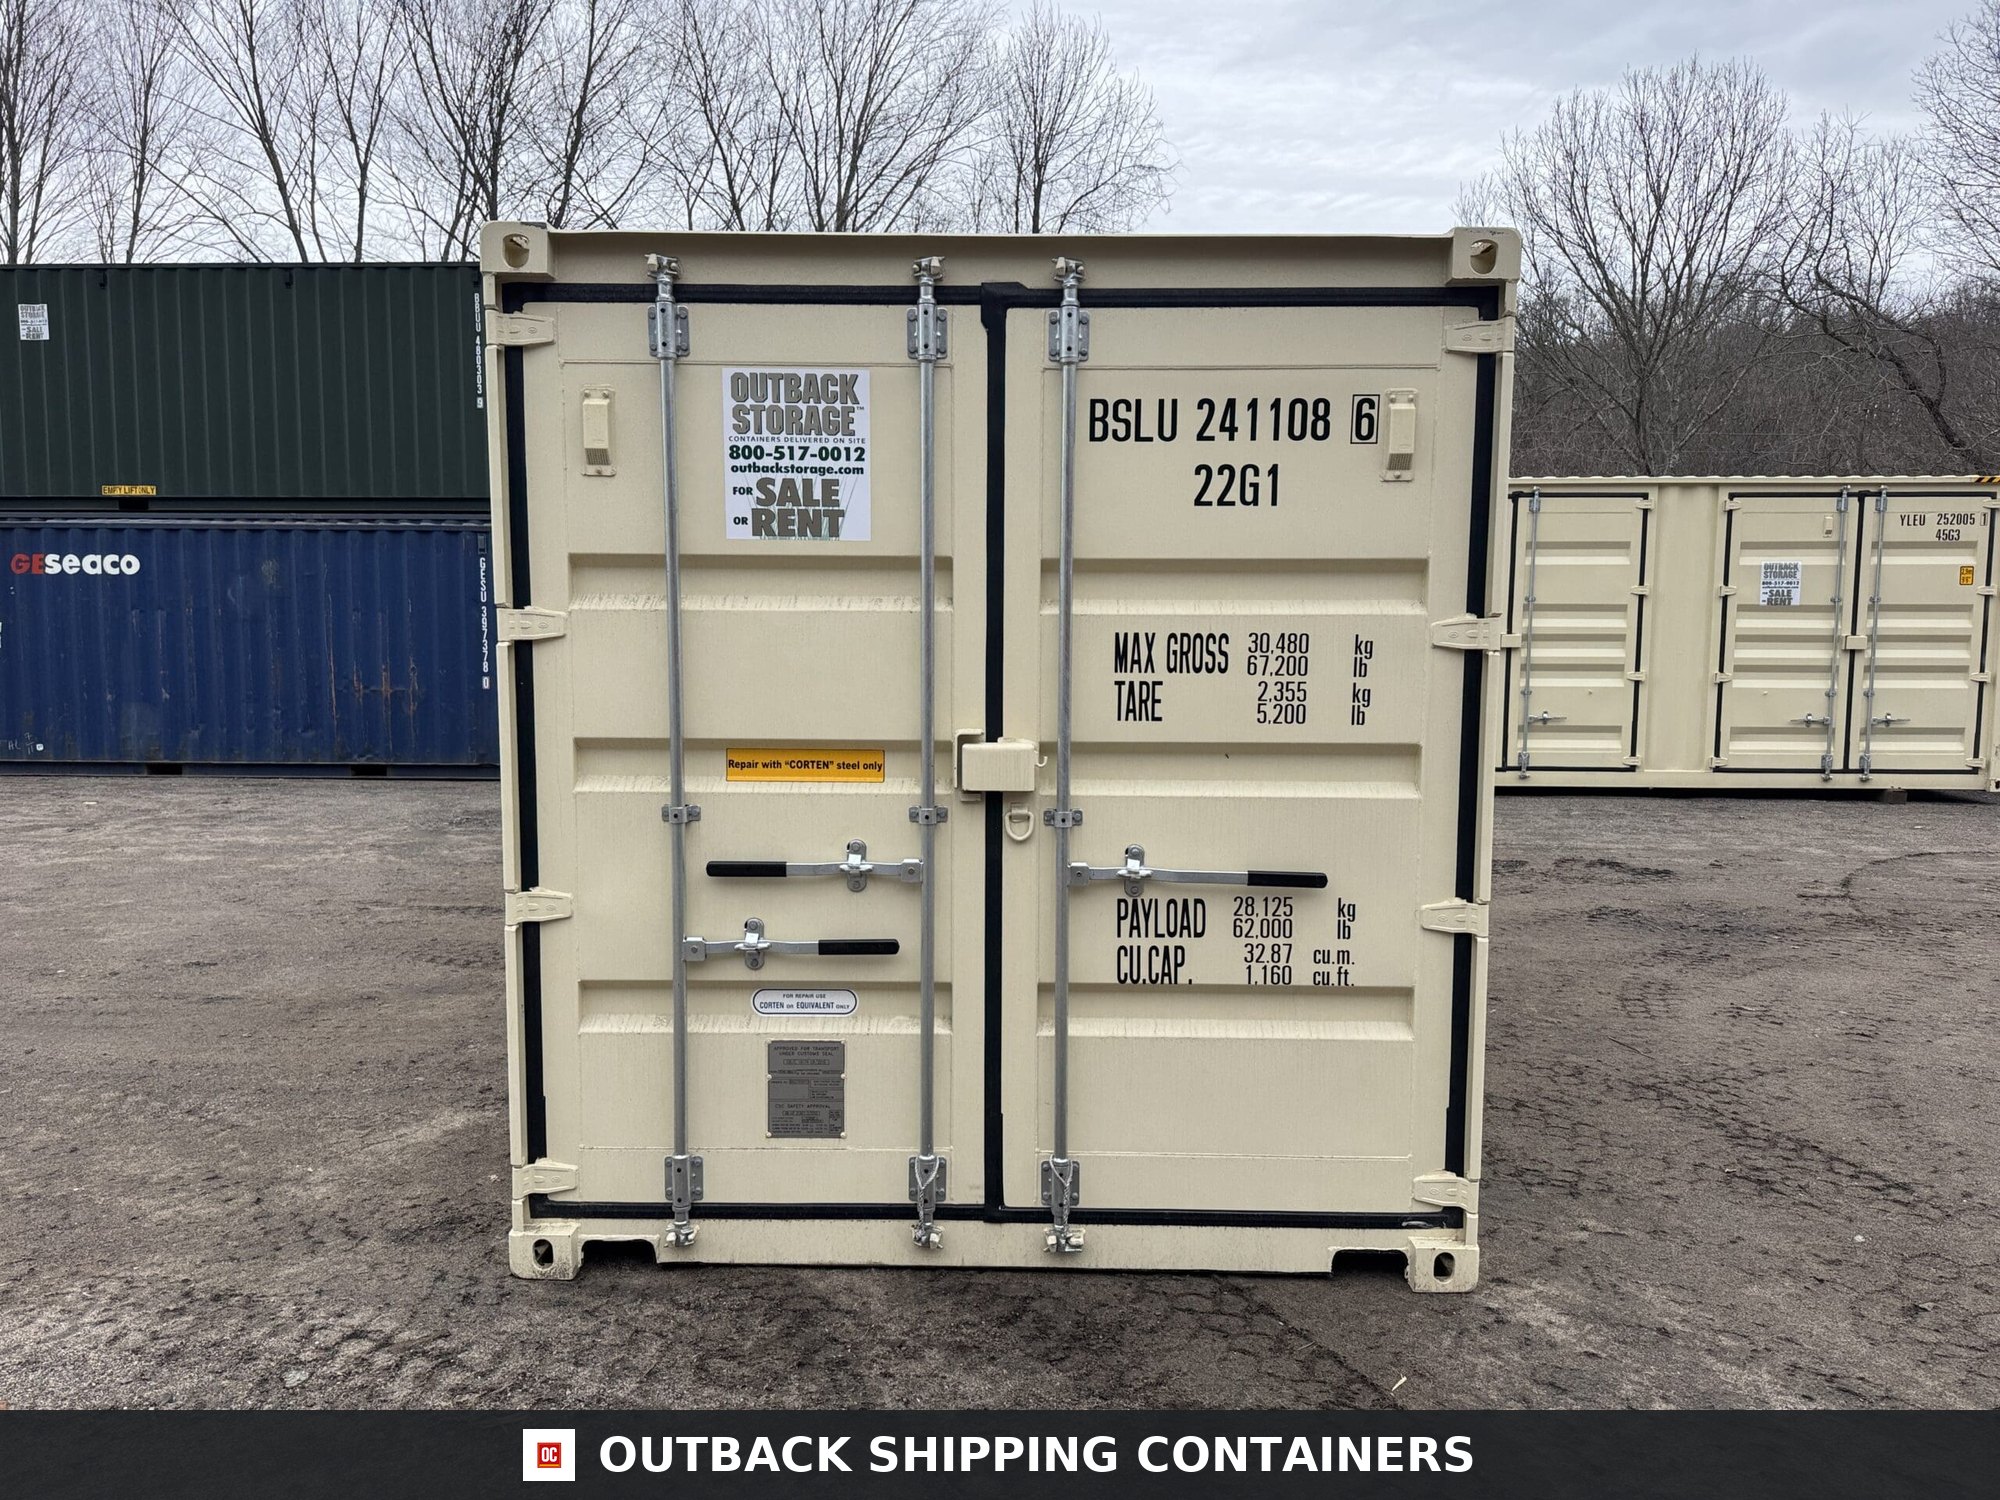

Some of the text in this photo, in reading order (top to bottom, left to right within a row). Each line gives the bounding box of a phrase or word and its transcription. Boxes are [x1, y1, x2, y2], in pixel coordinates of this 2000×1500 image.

[730, 372, 859, 404] OUTBACK
[1089, 396, 1376, 442] BSLU 241108 6
[728, 445, 865, 462] 800-517-0012
[731, 462, 864, 476] outbackstorage.com
[733, 478, 840, 508] FOR SALE
[1194, 464, 1279, 506] 22G1
[733, 508, 845, 537] OR RENT
[1900, 514, 1926, 526] YLEU
[1936, 513, 1975, 525] 252005
[1936, 529, 1960, 541] 45G3
[10, 554, 140, 575] GEseaco
[1763, 571, 1797, 579] STORAGE
[1767, 598, 1793, 606] RENT
[481, 606, 489, 672] 397378
[1114, 632, 1373, 674] MAX GROSS 30,480 kg
[1247, 655, 1368, 677] 67,200 lb
[1114, 680, 1370, 722] TARE 2,355 kg
[1257, 704, 1365, 725] 5,200 lb
[728, 759, 758, 771] Repair
[762, 760, 782, 769] with
[836, 761, 860, 770] steel
[863, 762, 882, 772] only
[1117, 896, 1356, 938] PAYLOAD 28,125 kg
[1233, 918, 1351, 940] 62,000 lb
[1117, 943, 1355, 985] CU.CAP. 32.87 cu.m.
[1246, 965, 1354, 986] 1,160 cu.ft.
